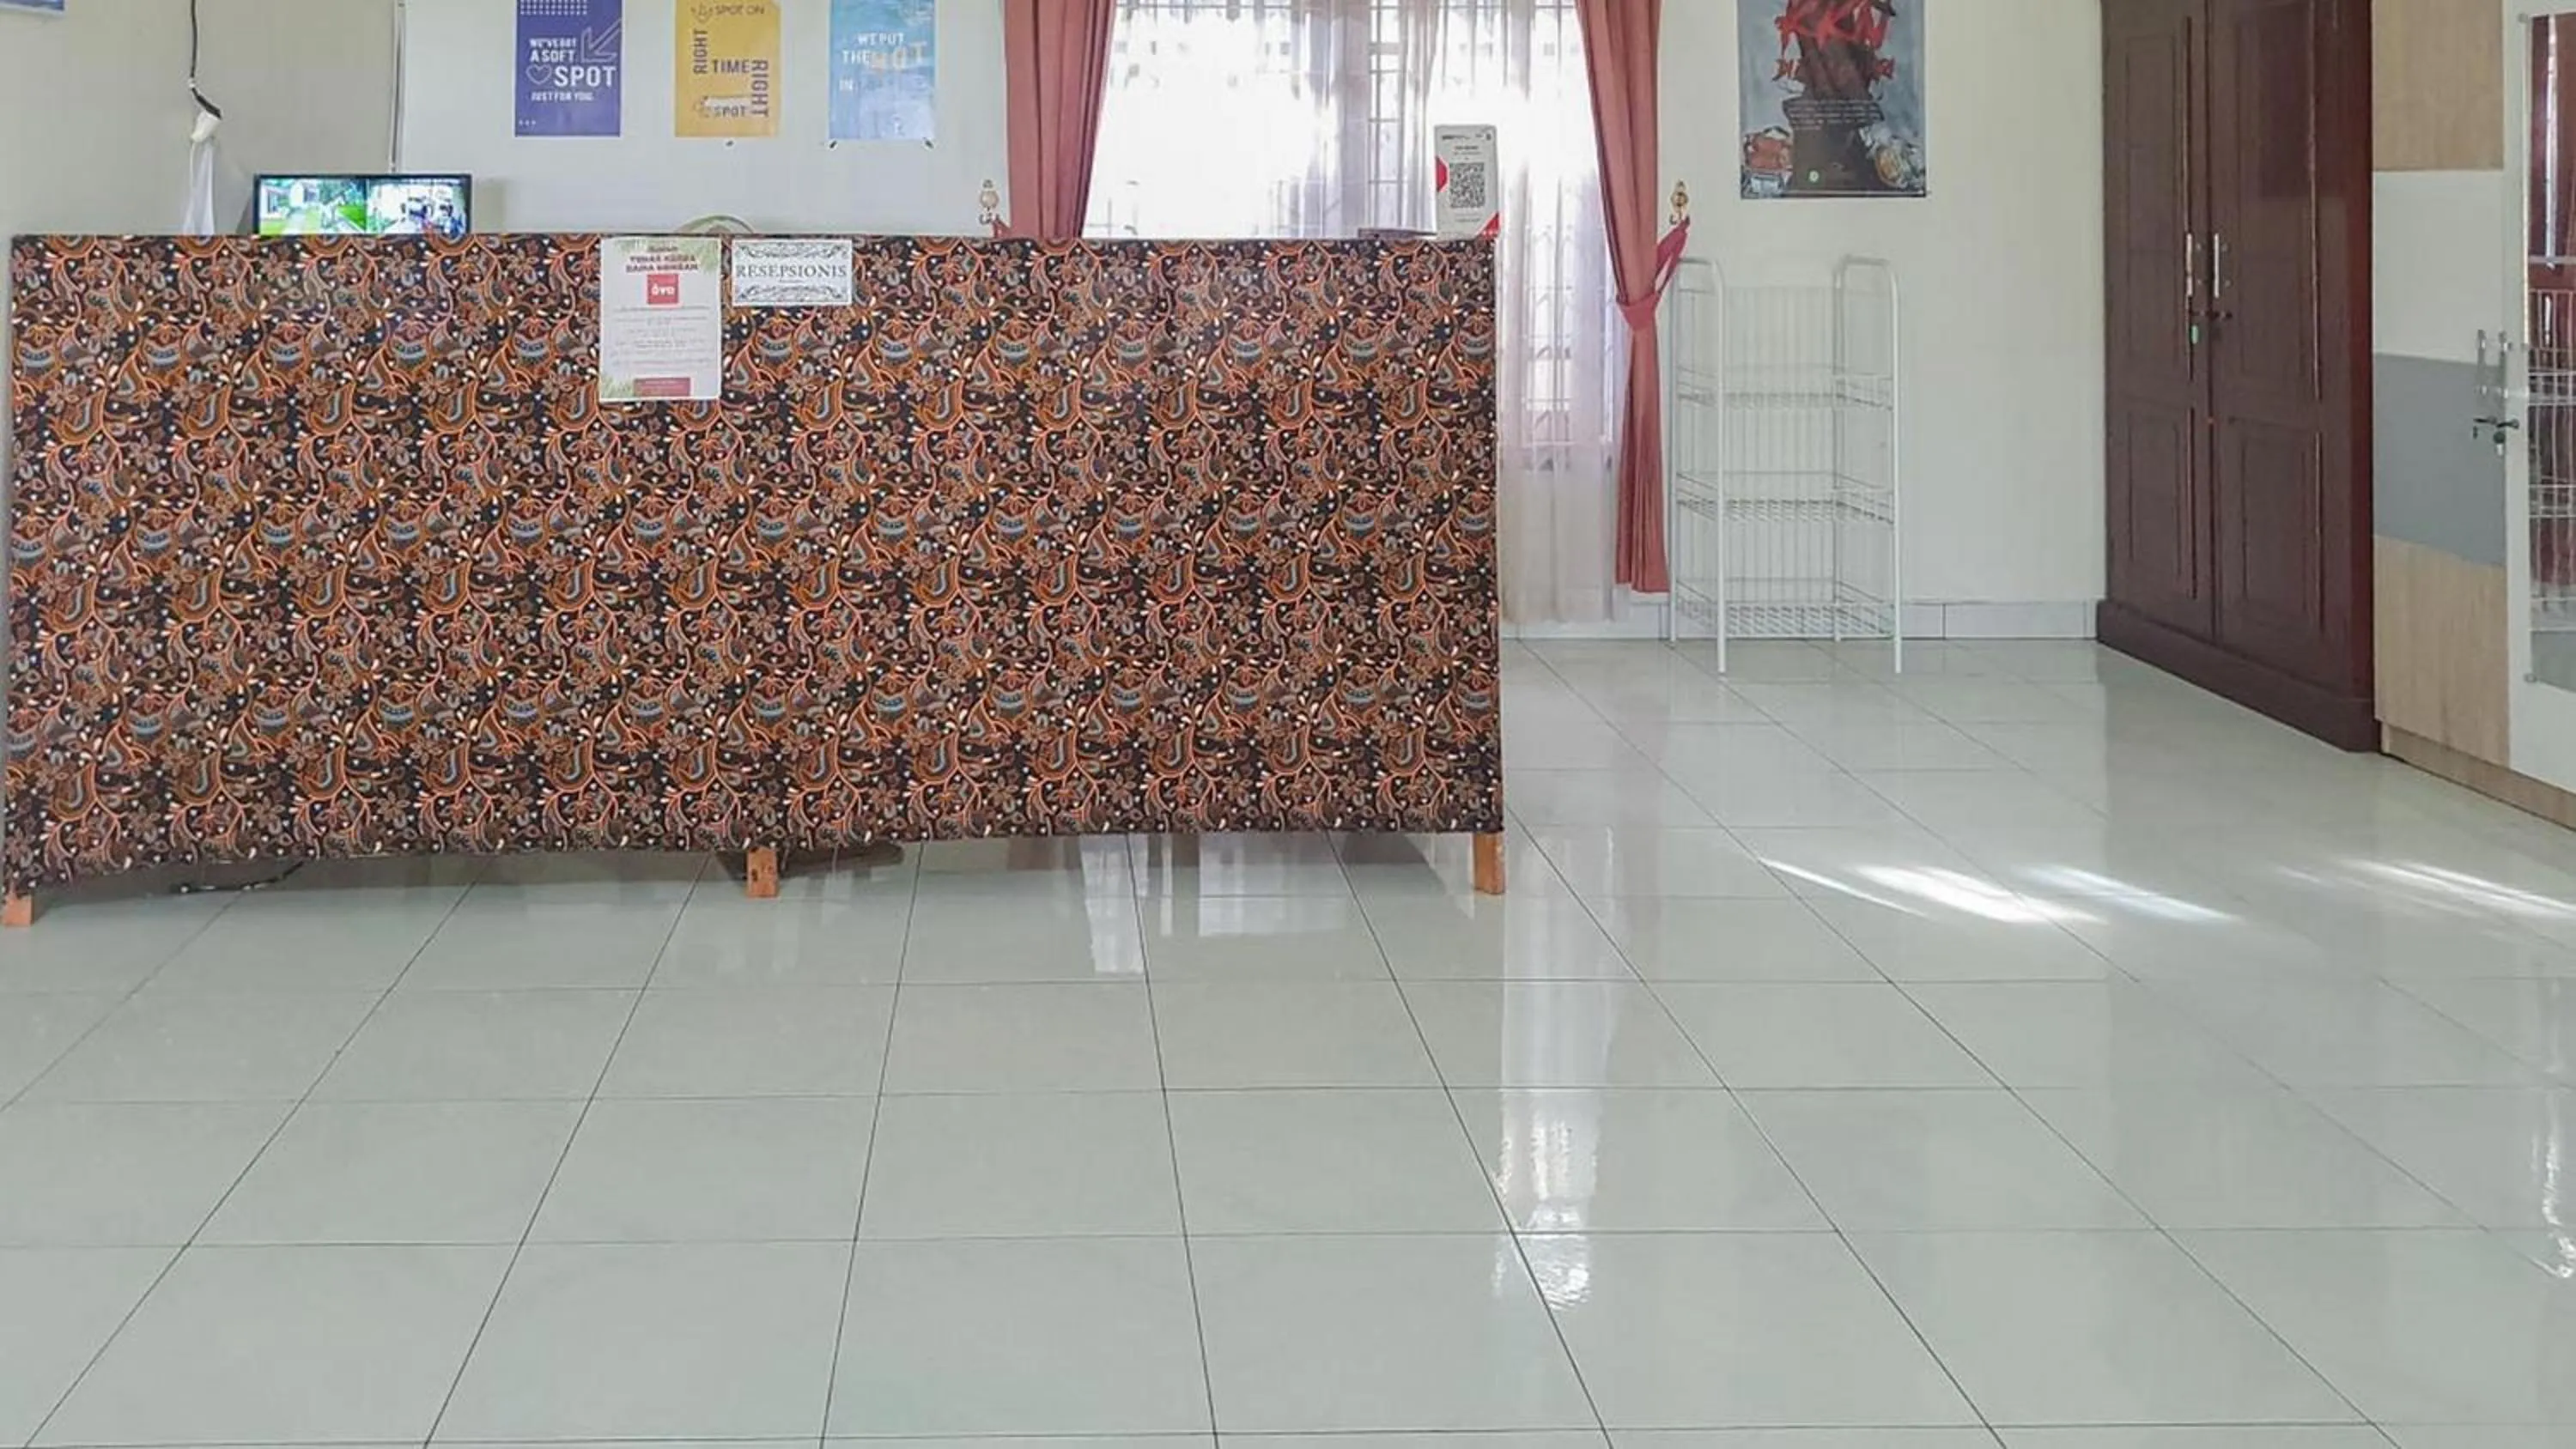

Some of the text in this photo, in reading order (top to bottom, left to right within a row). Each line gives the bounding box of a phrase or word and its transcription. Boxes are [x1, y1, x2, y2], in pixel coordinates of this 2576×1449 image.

[714, 3, 744, 15] SPOT
[530, 49, 576, 63] A SOFT
[692, 28, 708, 75] RIGHT
[712, 58, 750, 73] TIME
[554, 65, 617, 87] SPOT
[751, 59, 769, 118] RIGHT
[714, 105, 746, 118] SPOT
[736, 264, 847, 277] RESEPSIONIS
